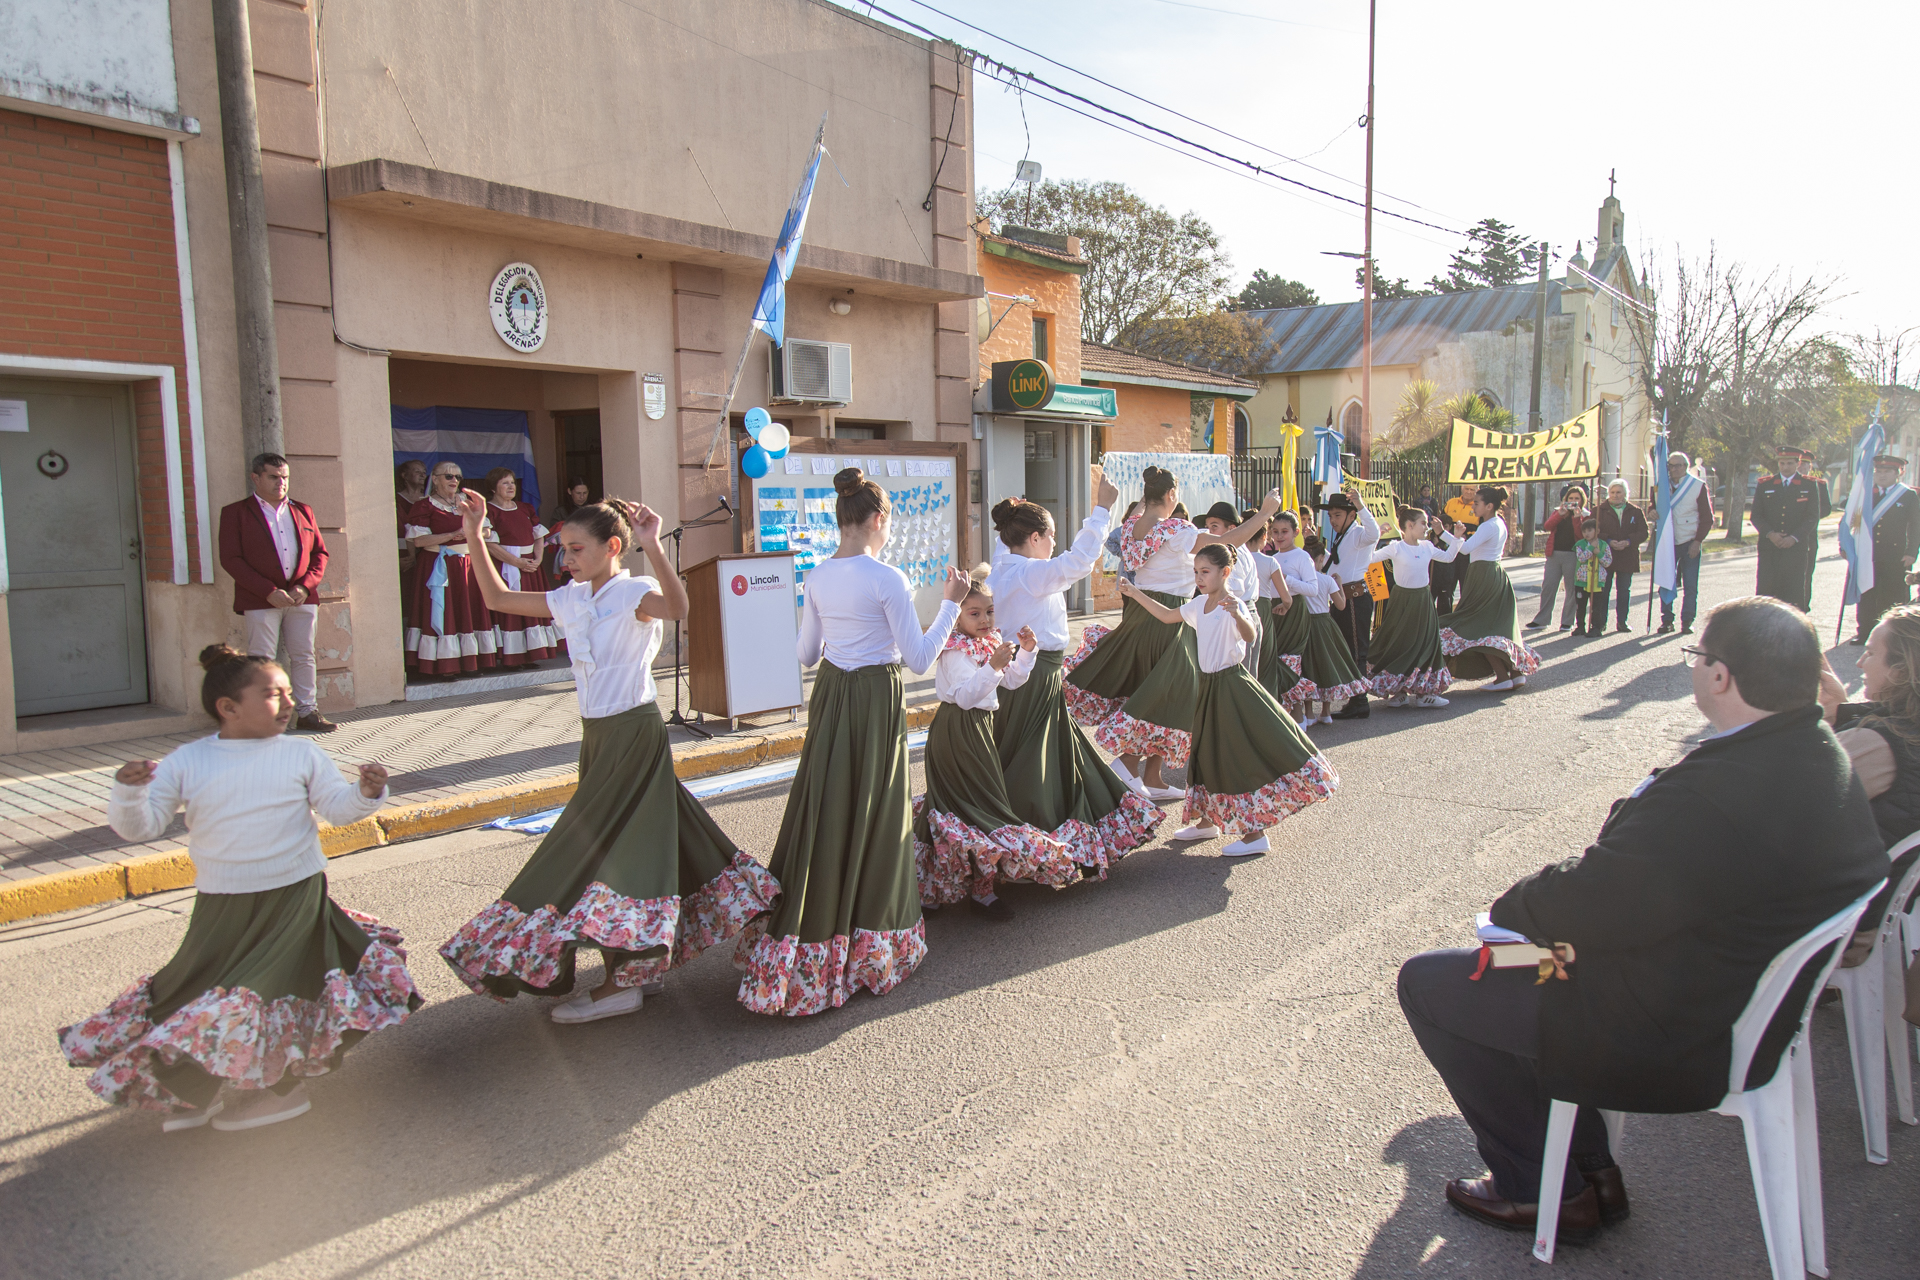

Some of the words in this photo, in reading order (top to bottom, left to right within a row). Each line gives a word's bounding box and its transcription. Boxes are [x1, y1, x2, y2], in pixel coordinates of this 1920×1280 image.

[494, 266, 527, 304] DELEGACION
[527, 270, 545, 309] MUNICIPAL
[503, 330, 542, 348] ARENAZA
[907, 462, 951, 477] BANDERA
[1460, 447, 1591, 480] ARENAZA
[1365, 483, 1389, 499] FUTBOL
[750, 574, 780, 585] Lincoln
[751, 583, 786, 592] Municipalidad
